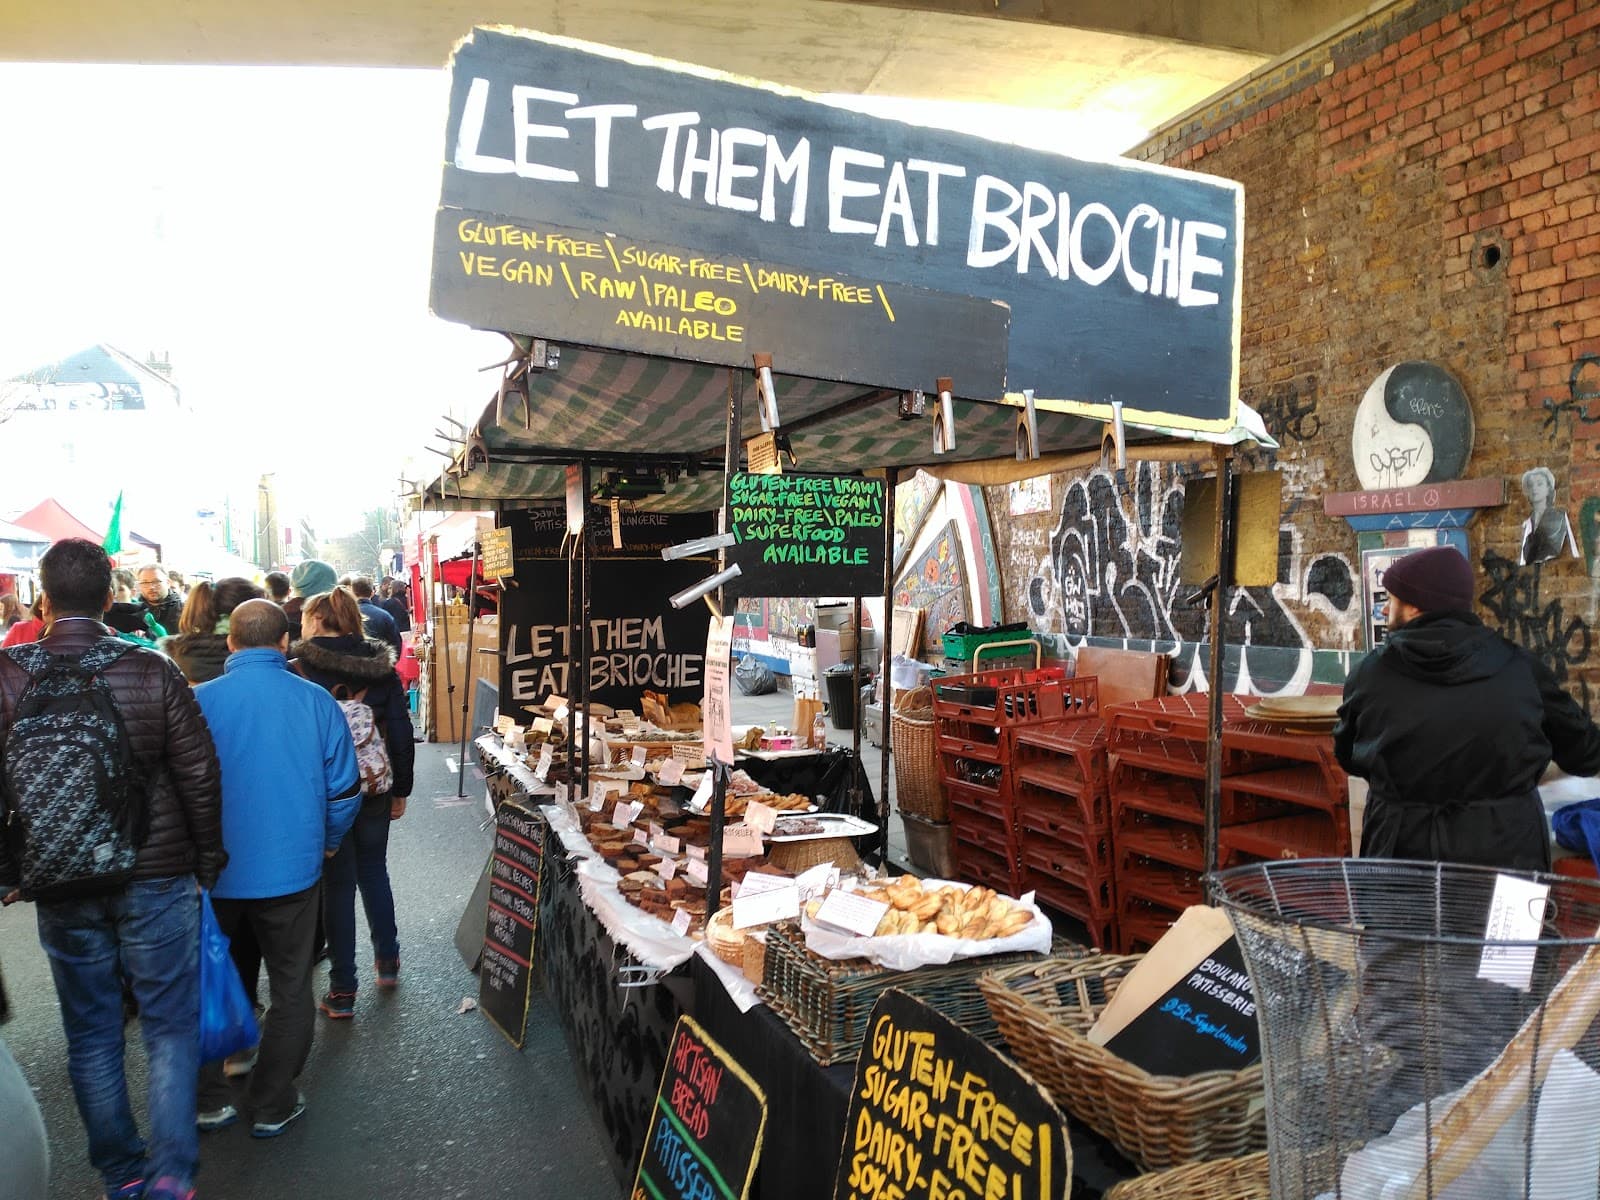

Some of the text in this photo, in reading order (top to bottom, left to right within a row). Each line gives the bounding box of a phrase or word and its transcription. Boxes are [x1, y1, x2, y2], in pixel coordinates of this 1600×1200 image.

[454, 77, 1227, 307] LET THEM EAT BRIOCHE
[459, 252, 553, 287] VEGAN
[616, 309, 744, 343] AVAILABLE
[1353, 491, 1415, 511] ISRAEL
[763, 543, 869, 565] AVAILABLE
[506, 615, 666, 665] LET THEM
[511, 653, 703, 700] EAT BRIOCHE
[1187, 973, 1256, 1017] PATISSERIE
[673, 1031, 723, 1105] ARTISAN
[671, 1079, 709, 1139] BREAD
